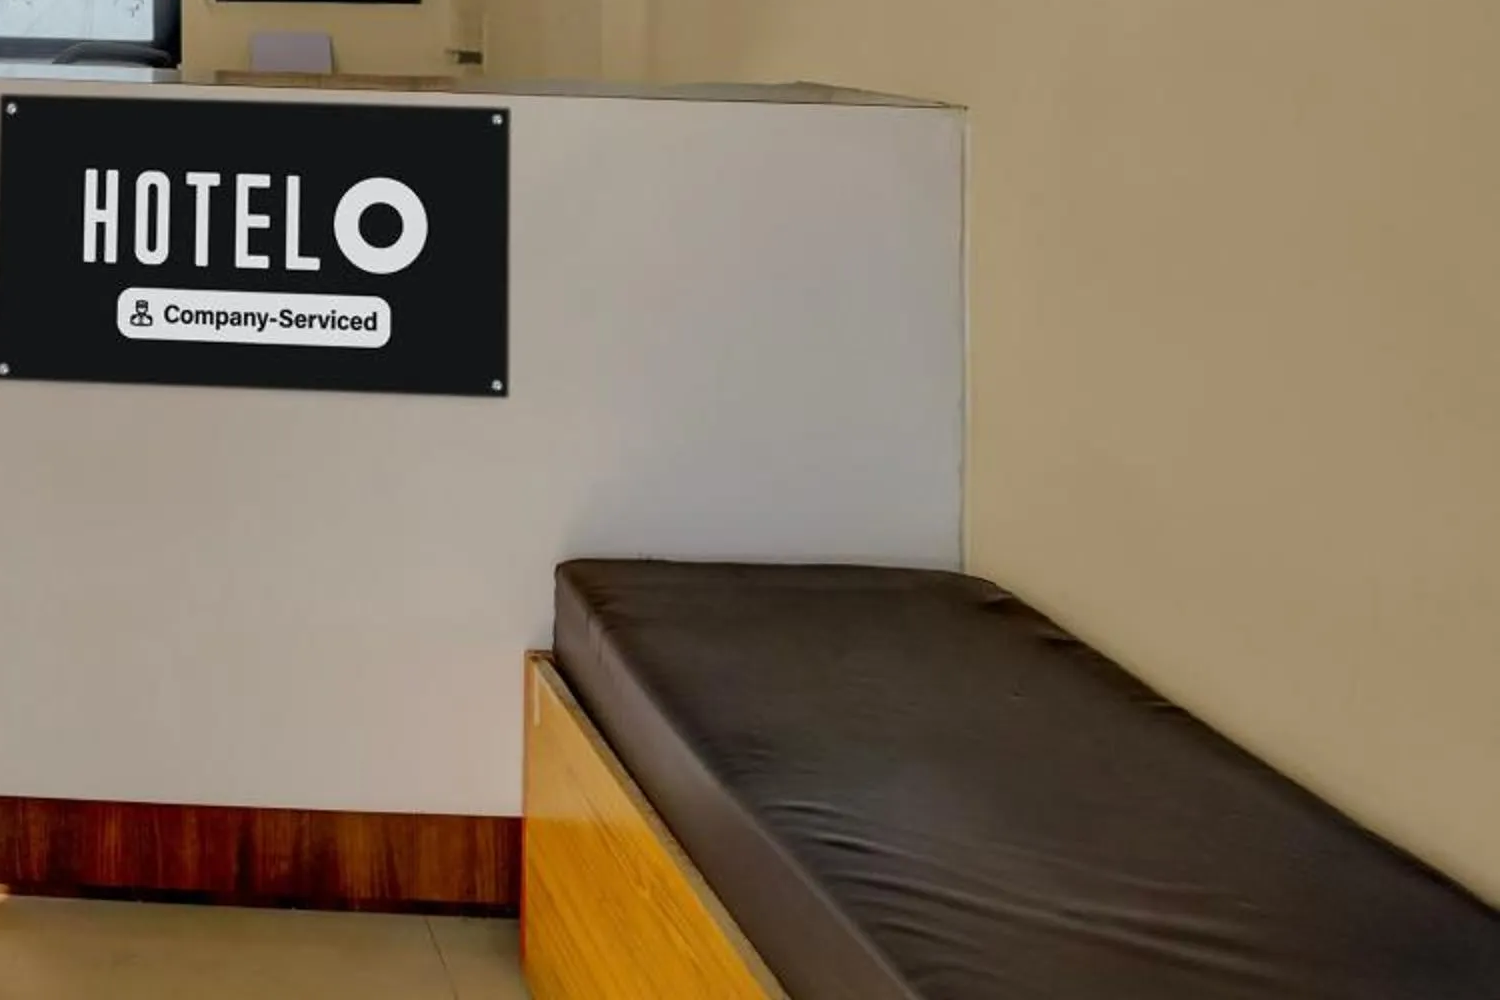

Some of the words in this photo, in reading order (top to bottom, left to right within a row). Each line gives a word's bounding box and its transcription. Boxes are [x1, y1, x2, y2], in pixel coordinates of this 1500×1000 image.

[83, 168, 321, 271] HOTEL
[333, 177, 429, 275] O
[163, 304, 379, 332] Company-Serviced
